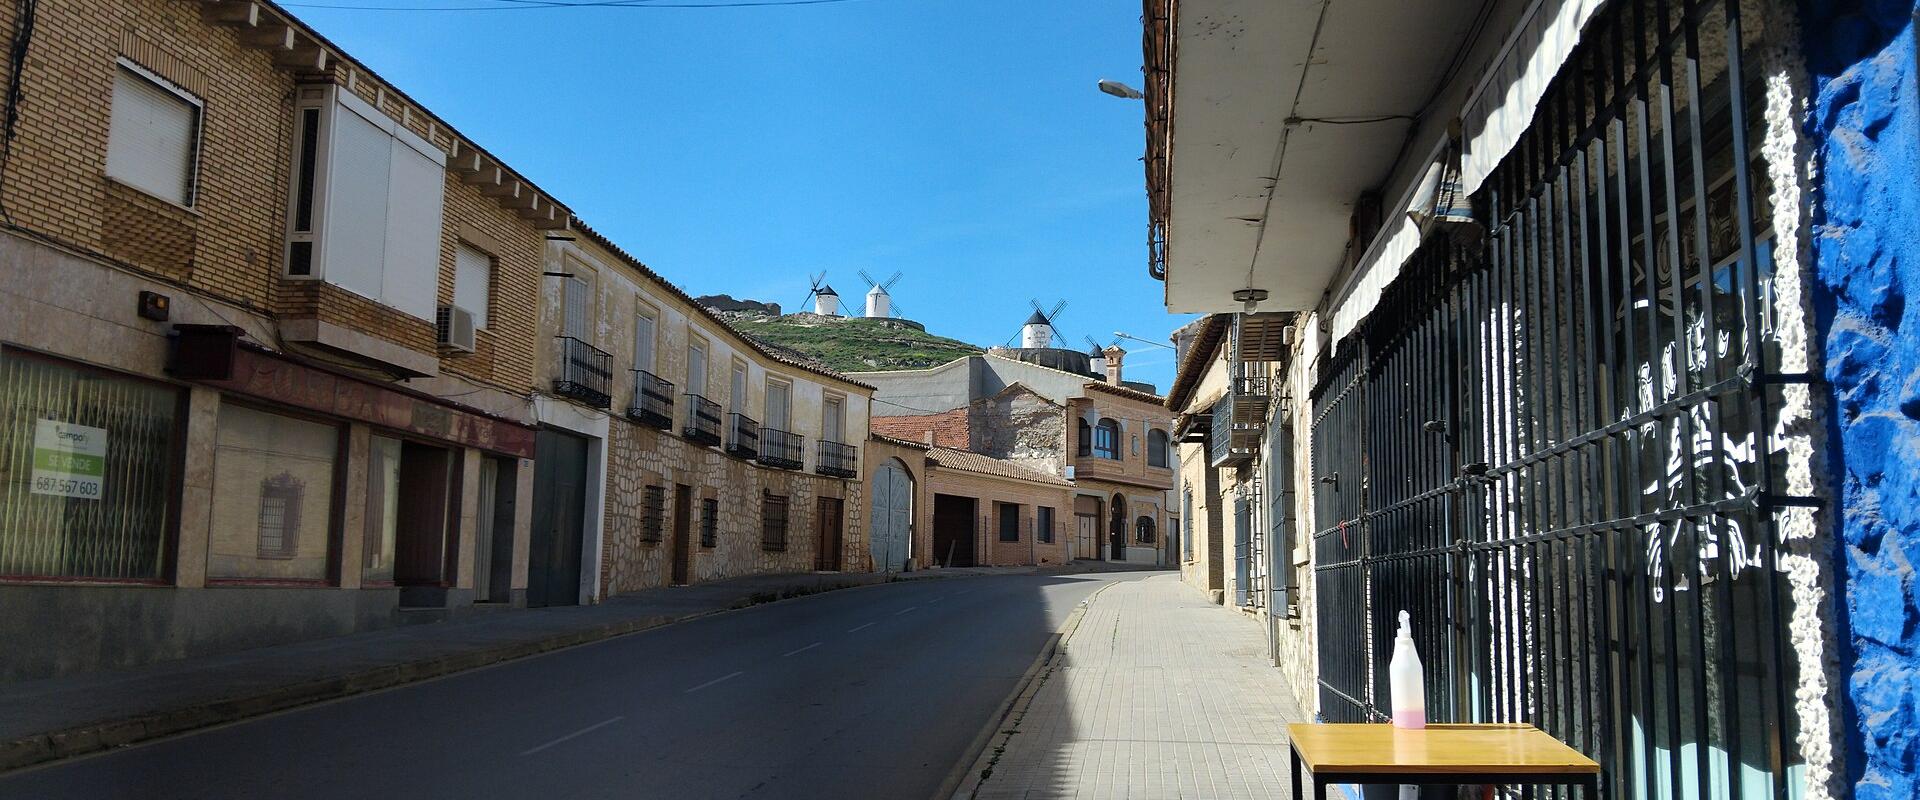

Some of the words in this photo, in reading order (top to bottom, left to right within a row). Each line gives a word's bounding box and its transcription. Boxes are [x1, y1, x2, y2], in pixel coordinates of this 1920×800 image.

[48, 454, 59, 467] SE
[61, 455, 91, 471] VENDE
[36, 476, 57, 491] 687
[59, 479, 78, 493] 567
[80, 481, 98, 496] 603
